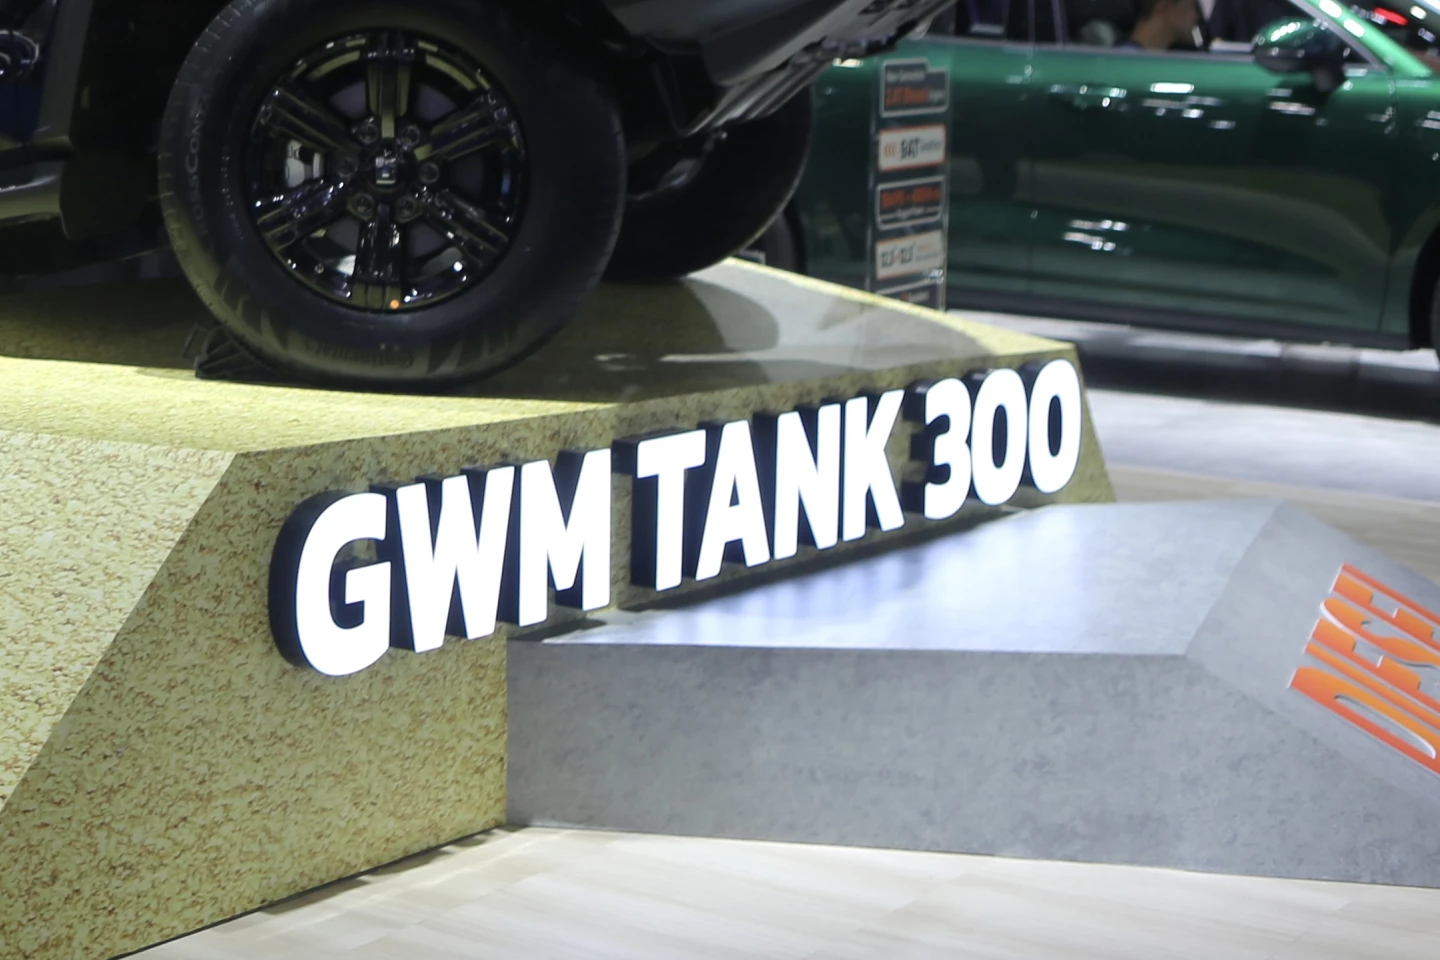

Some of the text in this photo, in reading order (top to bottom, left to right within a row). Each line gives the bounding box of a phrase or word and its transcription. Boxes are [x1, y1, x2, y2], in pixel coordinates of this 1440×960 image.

[293, 358, 1082, 676] GWM TANK 300
